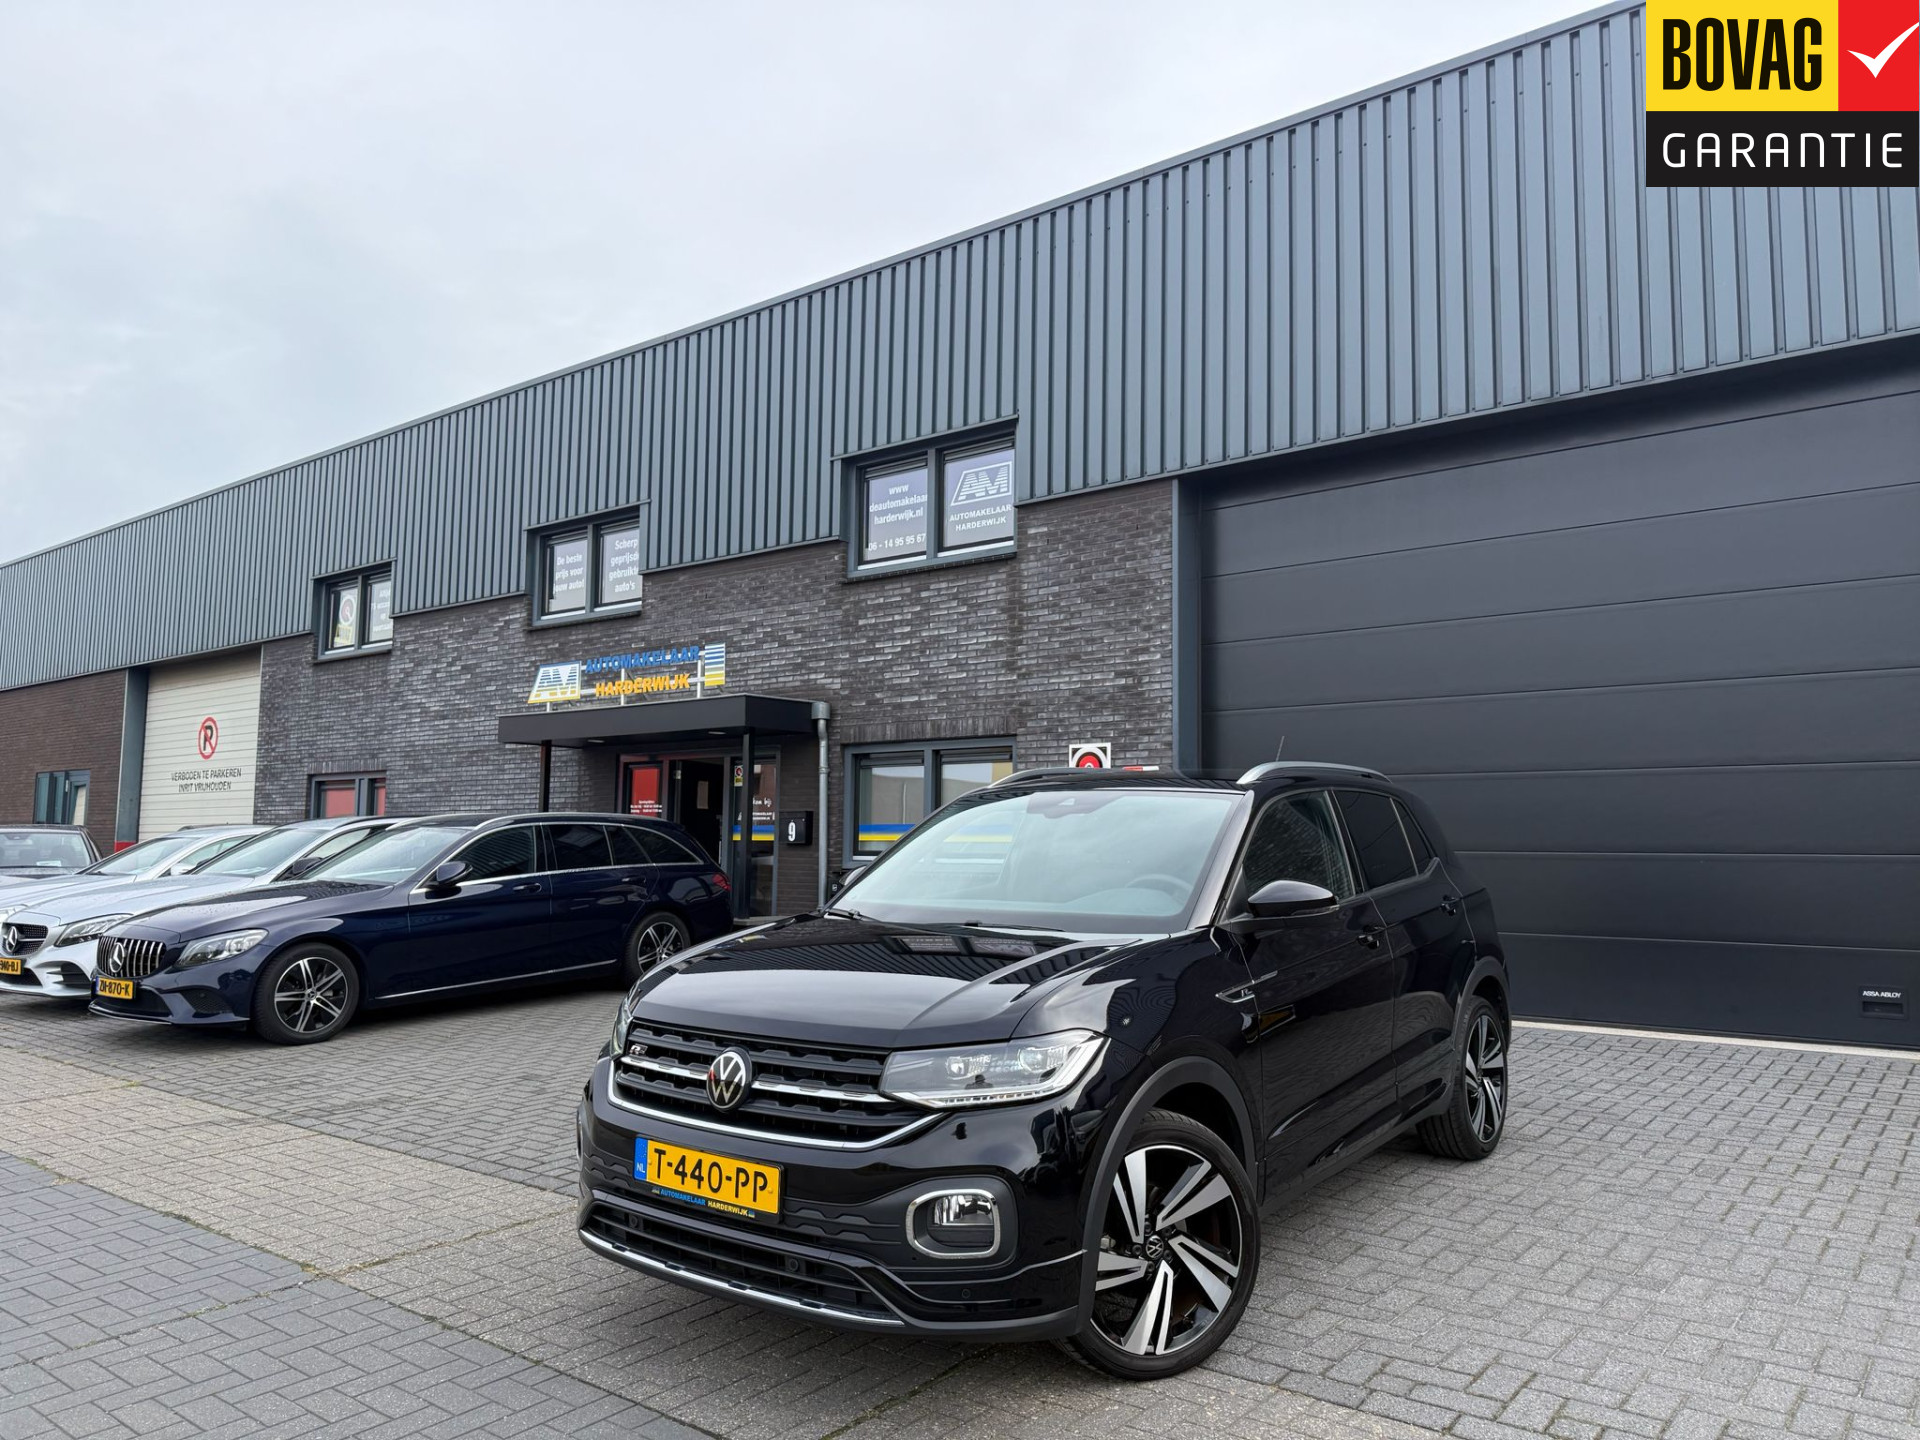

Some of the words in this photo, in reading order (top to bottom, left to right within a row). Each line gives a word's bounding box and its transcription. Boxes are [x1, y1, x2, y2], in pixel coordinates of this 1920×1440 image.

[889, 485, 909, 495] www
[874, 507, 923, 524] harderwijk.nl
[949, 504, 1012, 522] AUTOMAKELAAR
[955, 516, 1007, 531] HARDERWIJK
[614, 539, 638, 550] Scherp
[885, 539, 894, 549] 14
[894, 537, 904, 547] 95
[905, 535, 915, 545] 95
[916, 533, 927, 543] 67
[566, 553, 583, 564] beste
[570, 567, 584, 577] voor
[614, 581, 636, 593] auto's
[584, 645, 701, 674] AUTOMAKELAAR
[595, 673, 691, 697] HARDERWIJK
[202, 770, 209, 779] TE
[210, 768, 242, 779] PARKEREN
[787, 821, 796, 841] 9
[636, 1163, 646, 1174] NL
[653, 1147, 769, 1203] T-440-PP
[660, 1188, 706, 1206] AUTOMAKELAAR
[707, 1200, 748, 1217] HARDERWIJK
